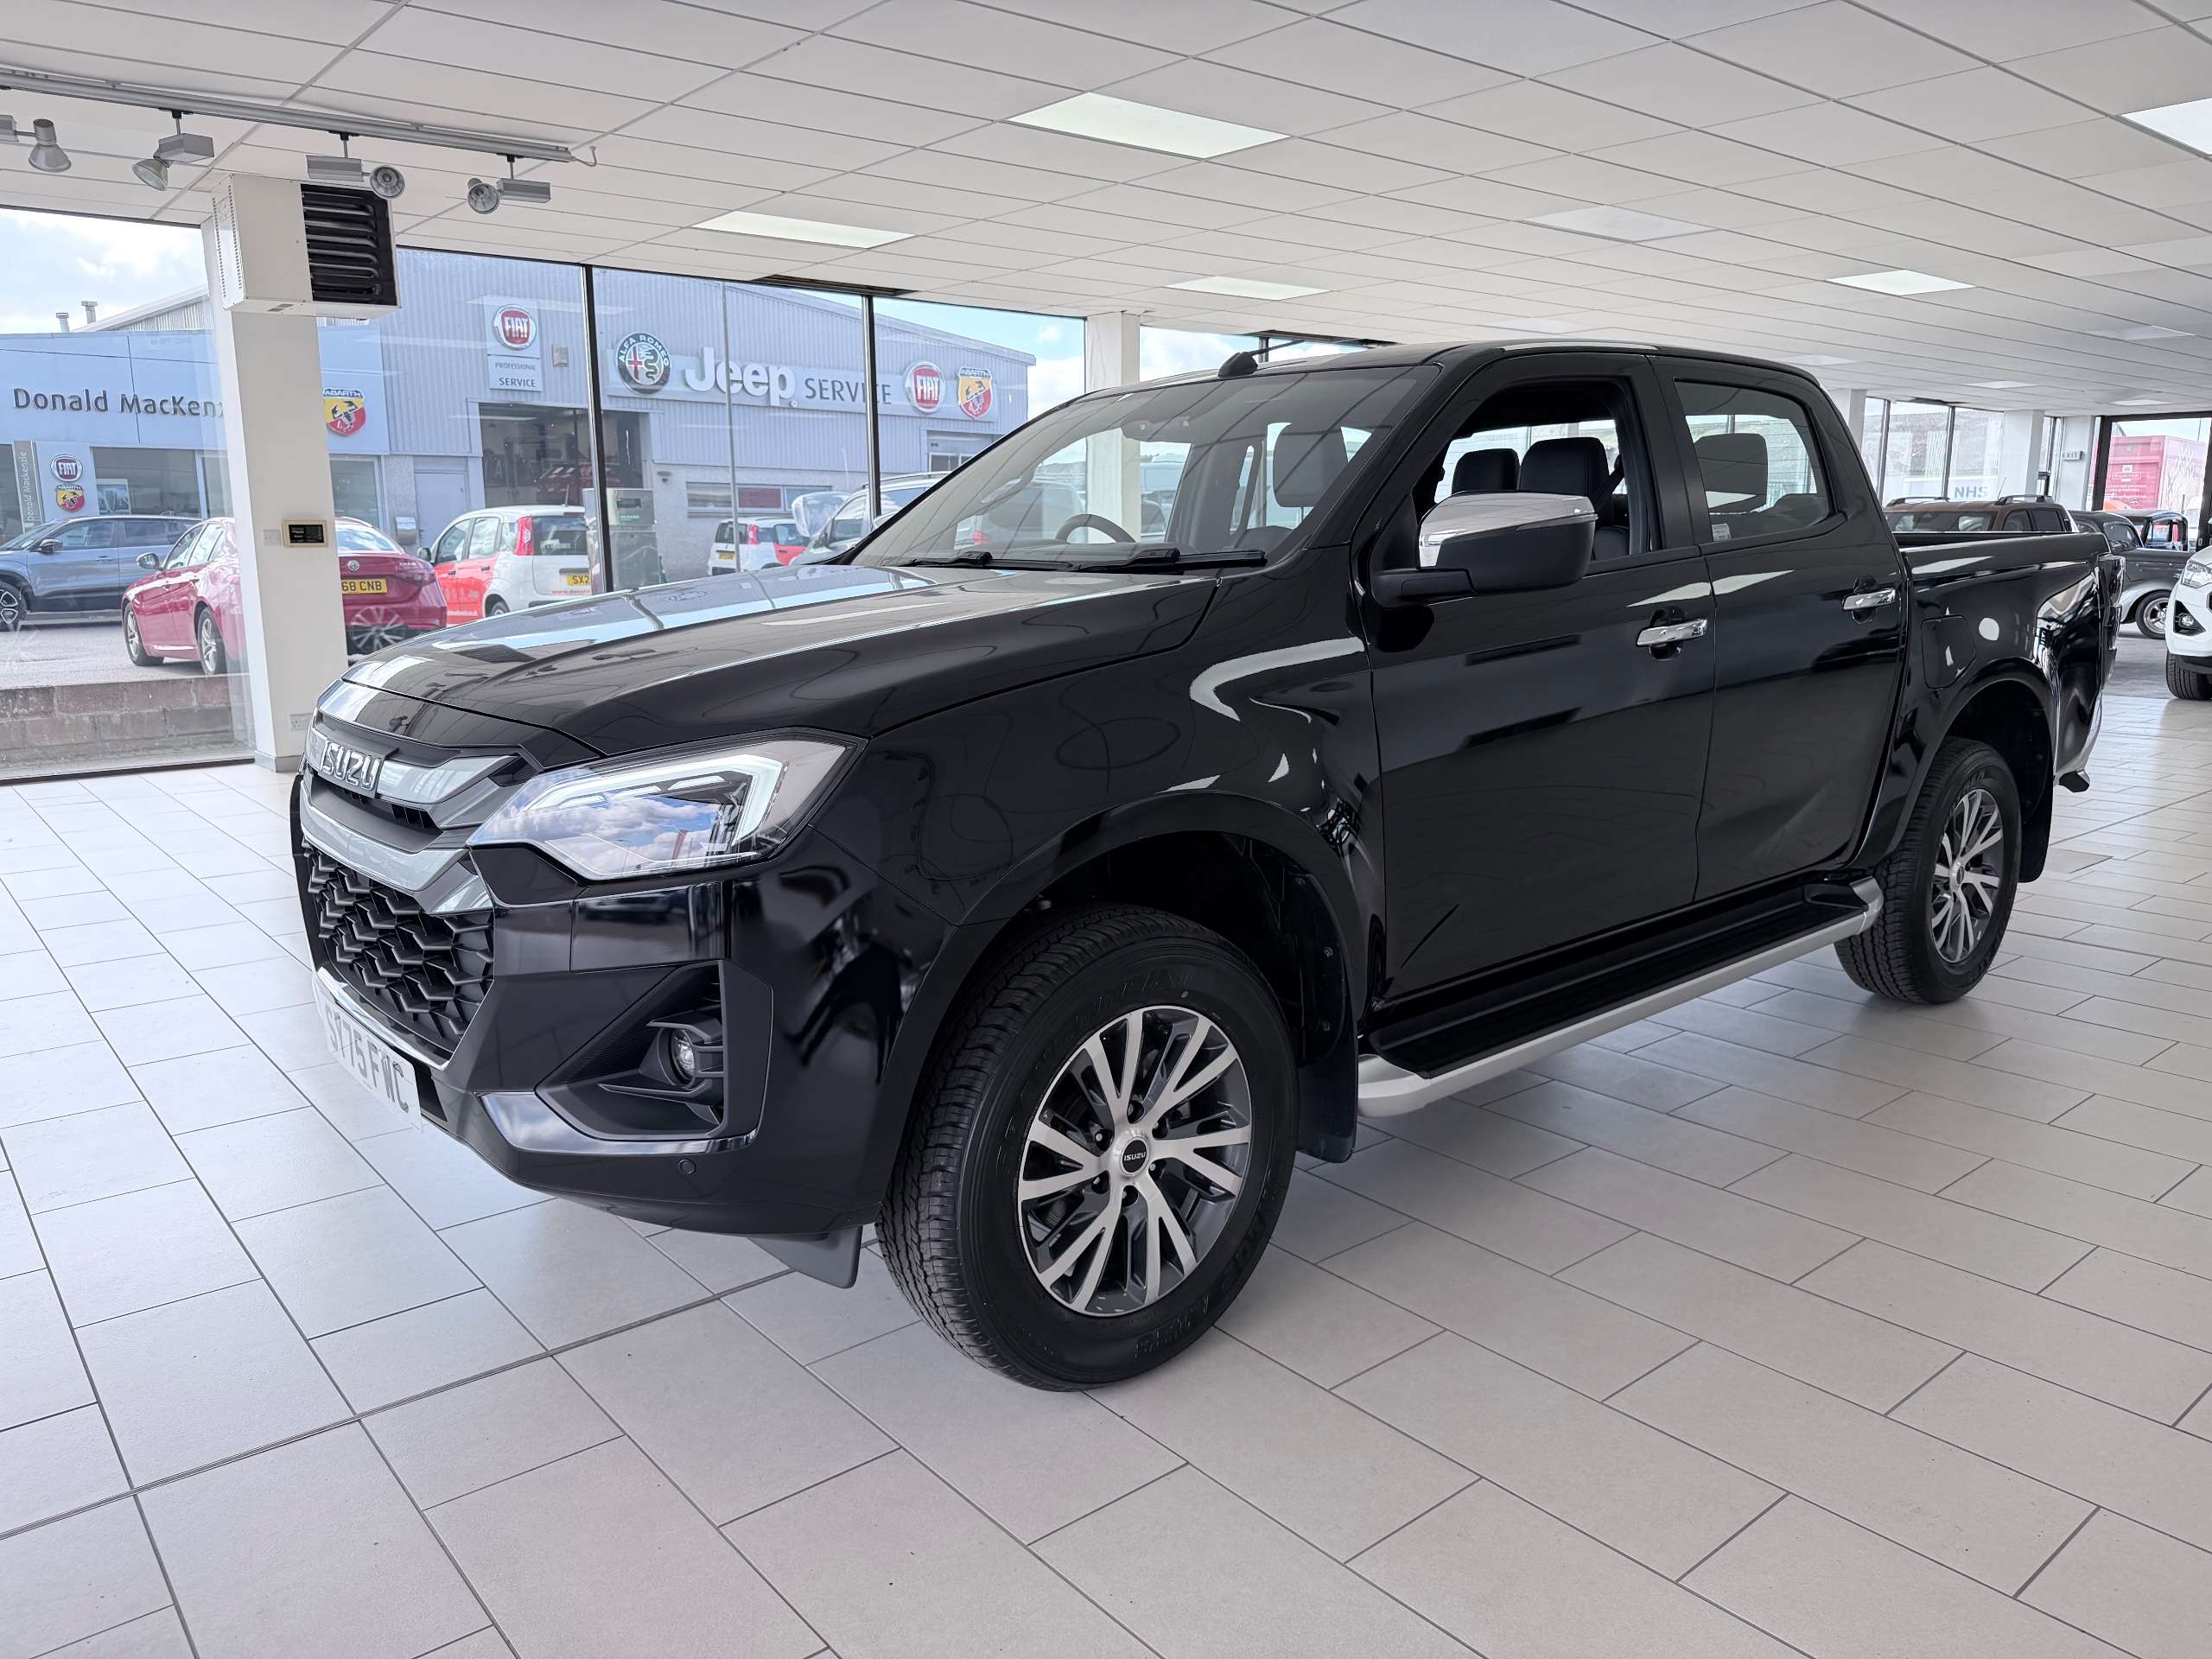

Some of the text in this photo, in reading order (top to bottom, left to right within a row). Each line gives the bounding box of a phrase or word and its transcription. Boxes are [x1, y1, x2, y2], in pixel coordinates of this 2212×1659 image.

[504, 316, 528, 338] FIAT
[619, 334, 669, 365] ALFA ROMEO
[494, 362, 537, 371] PROFESSIONAL
[499, 377, 537, 388] SERVICE
[684, 346, 892, 406] Jeep SERVIE
[916, 374, 939, 401] FIAT
[14, 388, 109, 413] Donald
[58, 461, 77, 476] FIAT
[1955, 486, 1988, 499] NHS
[359, 580, 382, 591] CNB
[321, 740, 381, 791] ISUZU
[1123, 1151, 1147, 1161] ISUZU
